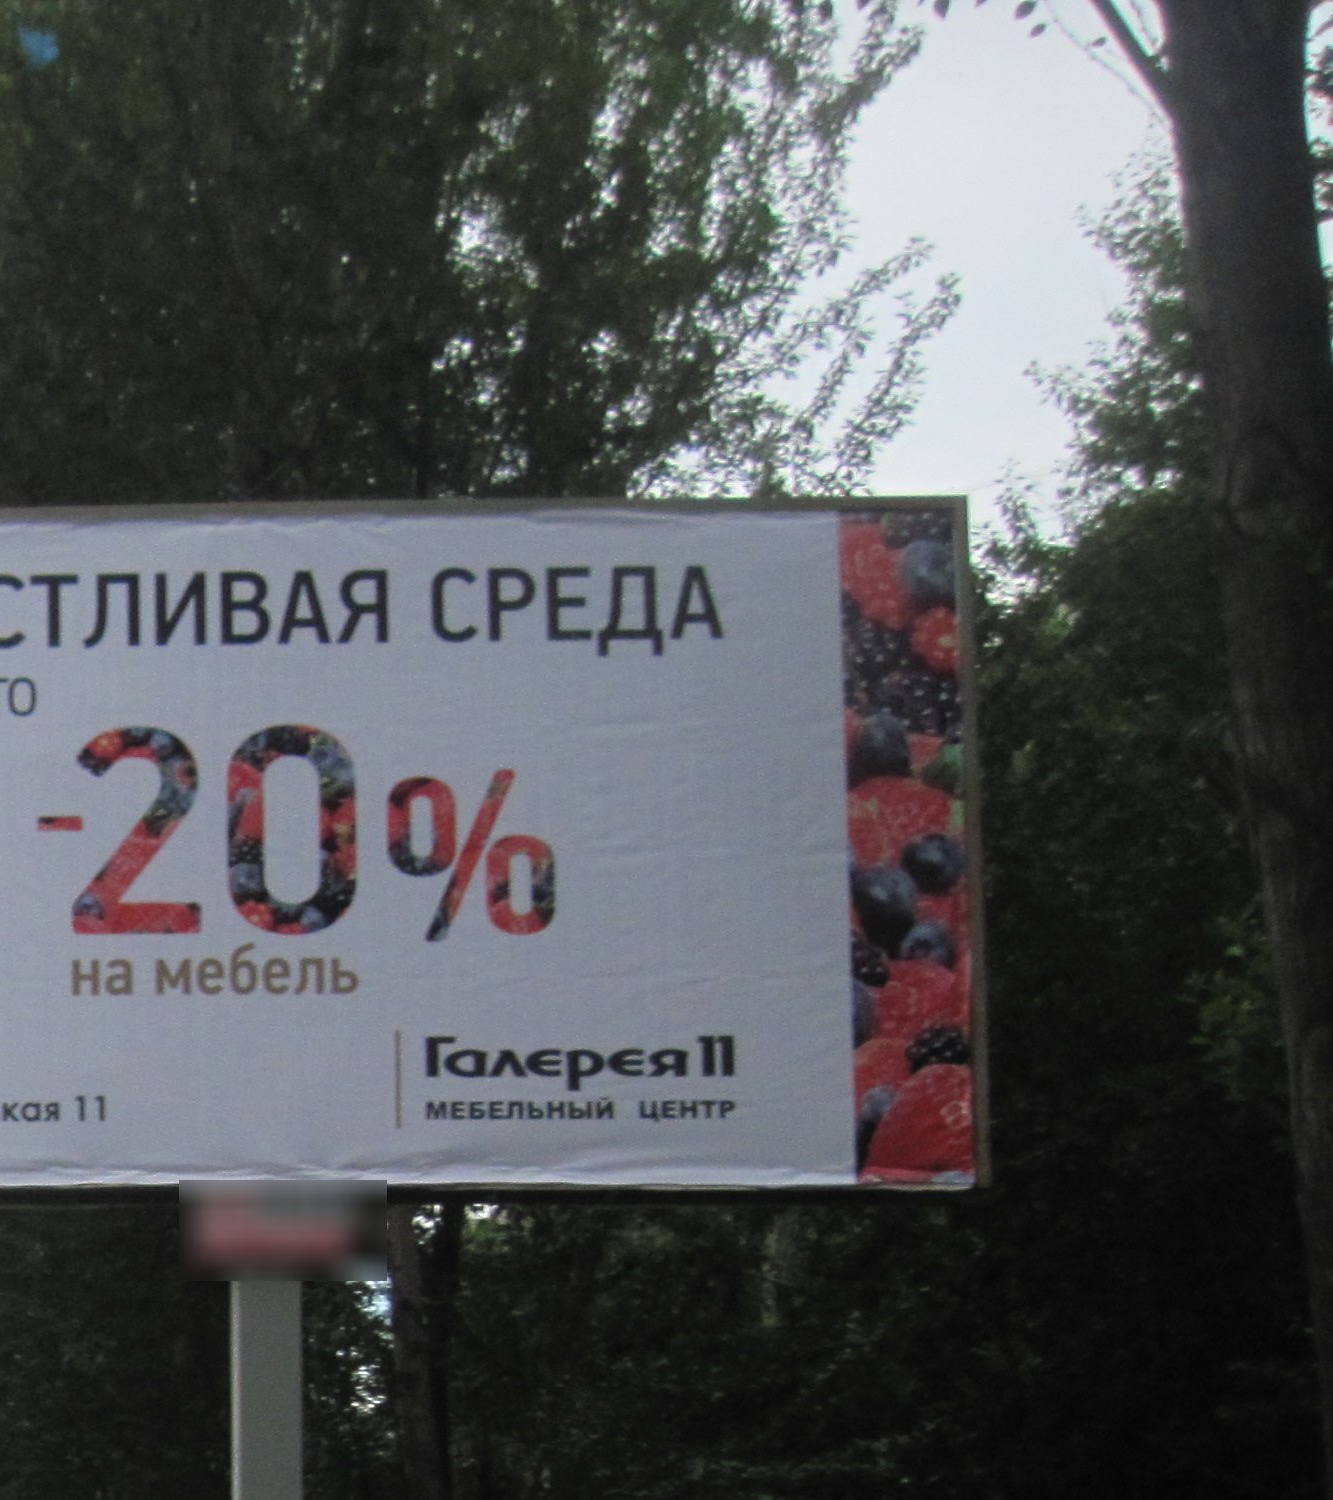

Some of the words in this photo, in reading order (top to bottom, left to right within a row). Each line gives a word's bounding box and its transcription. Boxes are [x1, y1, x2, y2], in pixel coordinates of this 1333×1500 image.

[430, 565, 725, 657] СРЕДА
[37, 724, 556, 942] -20%
[71, 957, 133, 996] на
[153, 943, 359, 996] мебель
[424, 1036, 689, 1091] Галерея
[74, 1095, 108, 1122] 11
[424, 1096, 615, 1121] МЕБЕЛЬНЫЙ
[638, 1099, 737, 1124] ЦЕНТР
